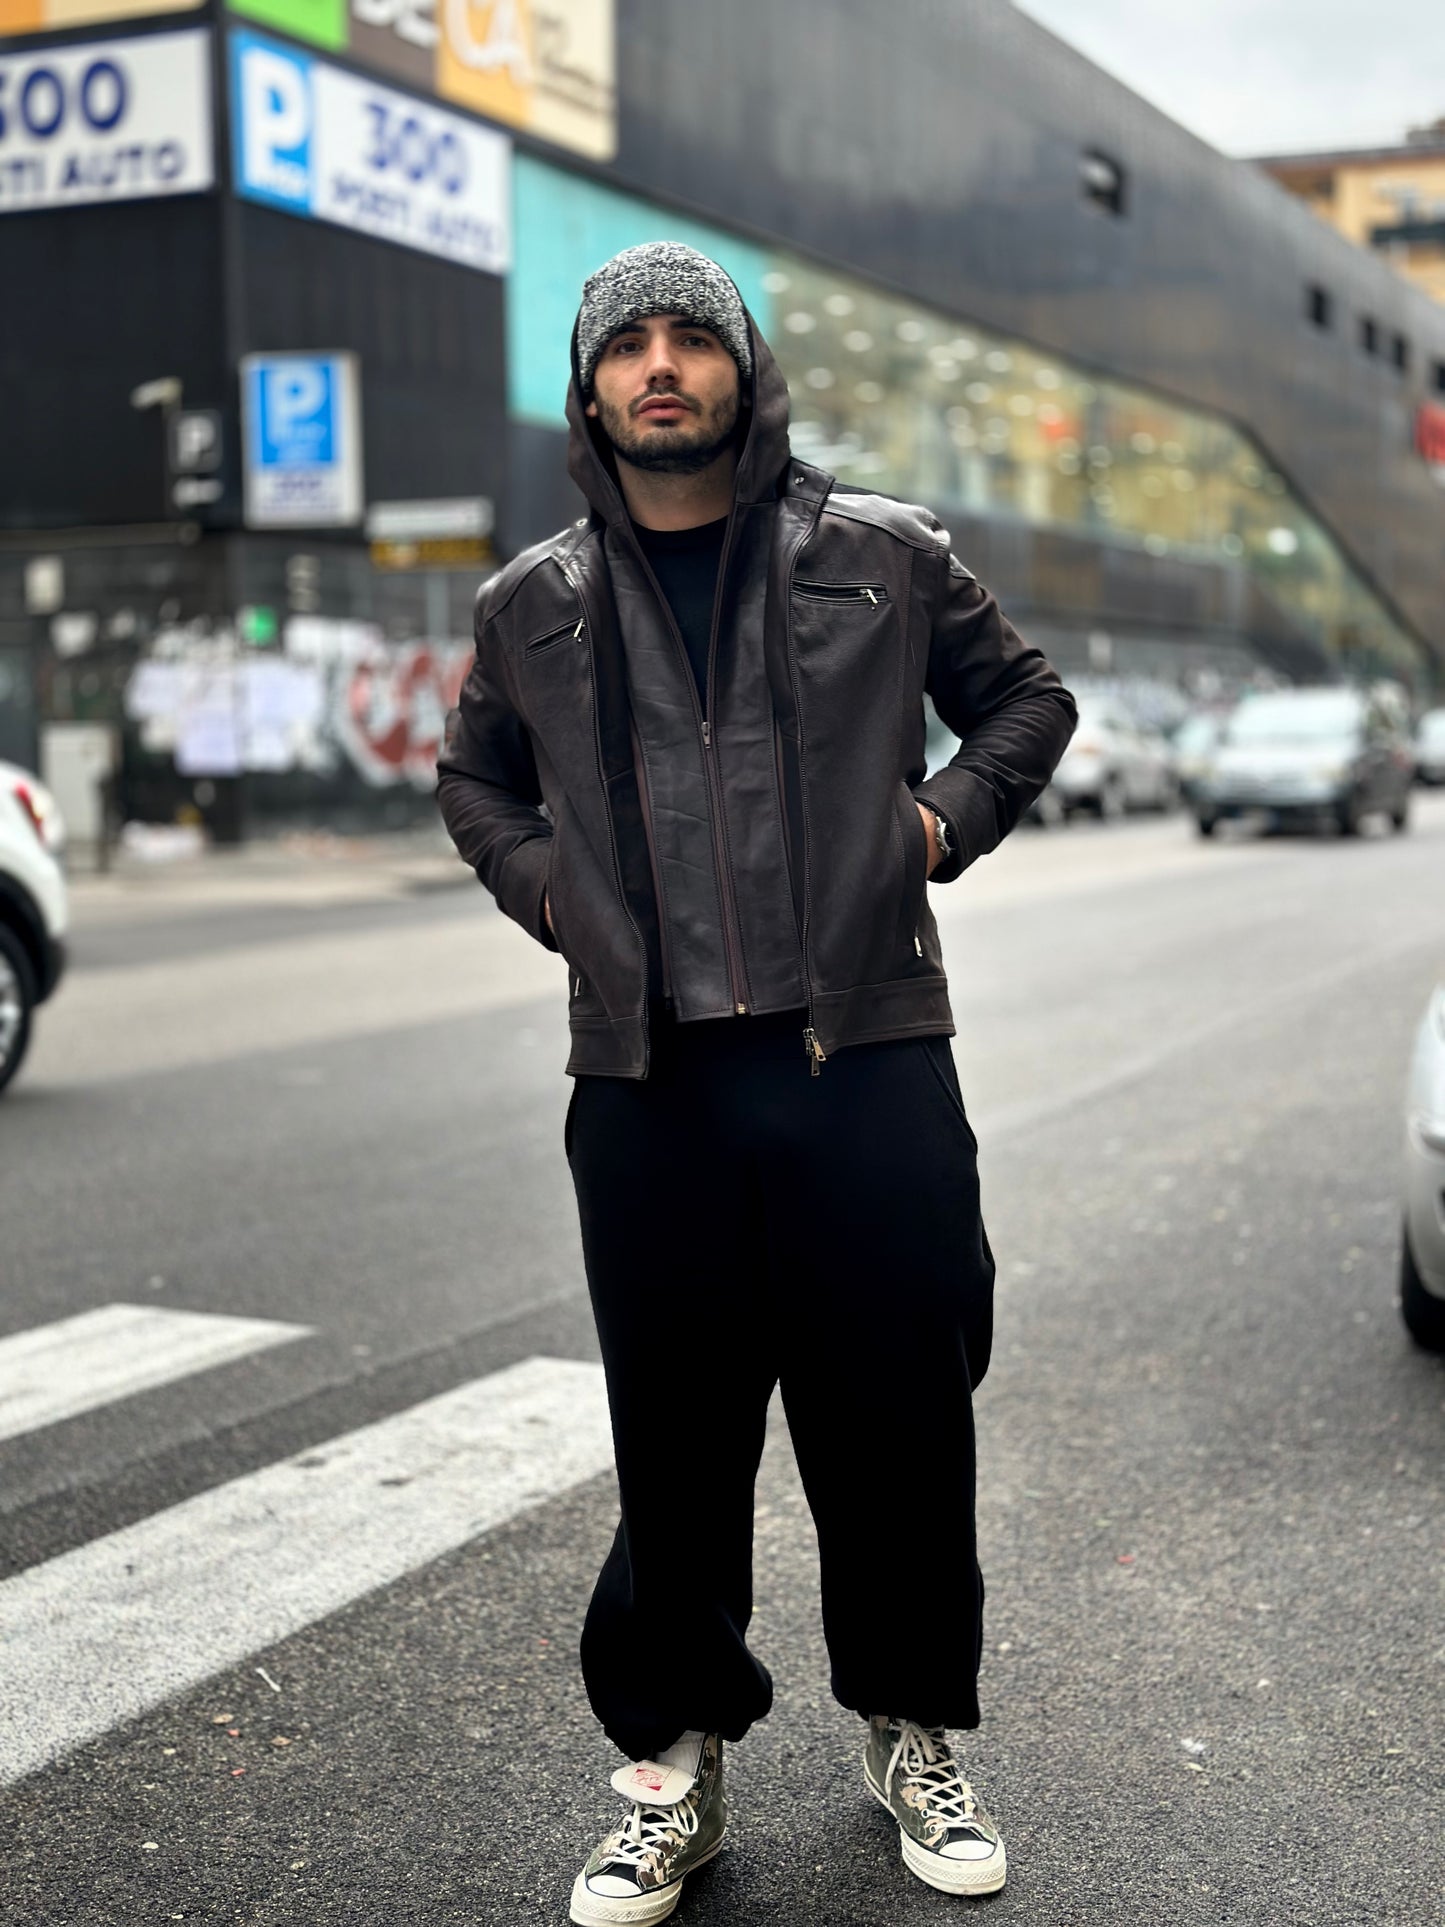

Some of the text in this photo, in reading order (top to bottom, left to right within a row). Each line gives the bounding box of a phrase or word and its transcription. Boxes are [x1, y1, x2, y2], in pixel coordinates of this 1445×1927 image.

[0, 62, 127, 140] 00
[241, 47, 309, 190] P
[0, 141, 187, 196] TI AUTO
[366, 98, 468, 198] 300
[266, 357, 328, 443] P
